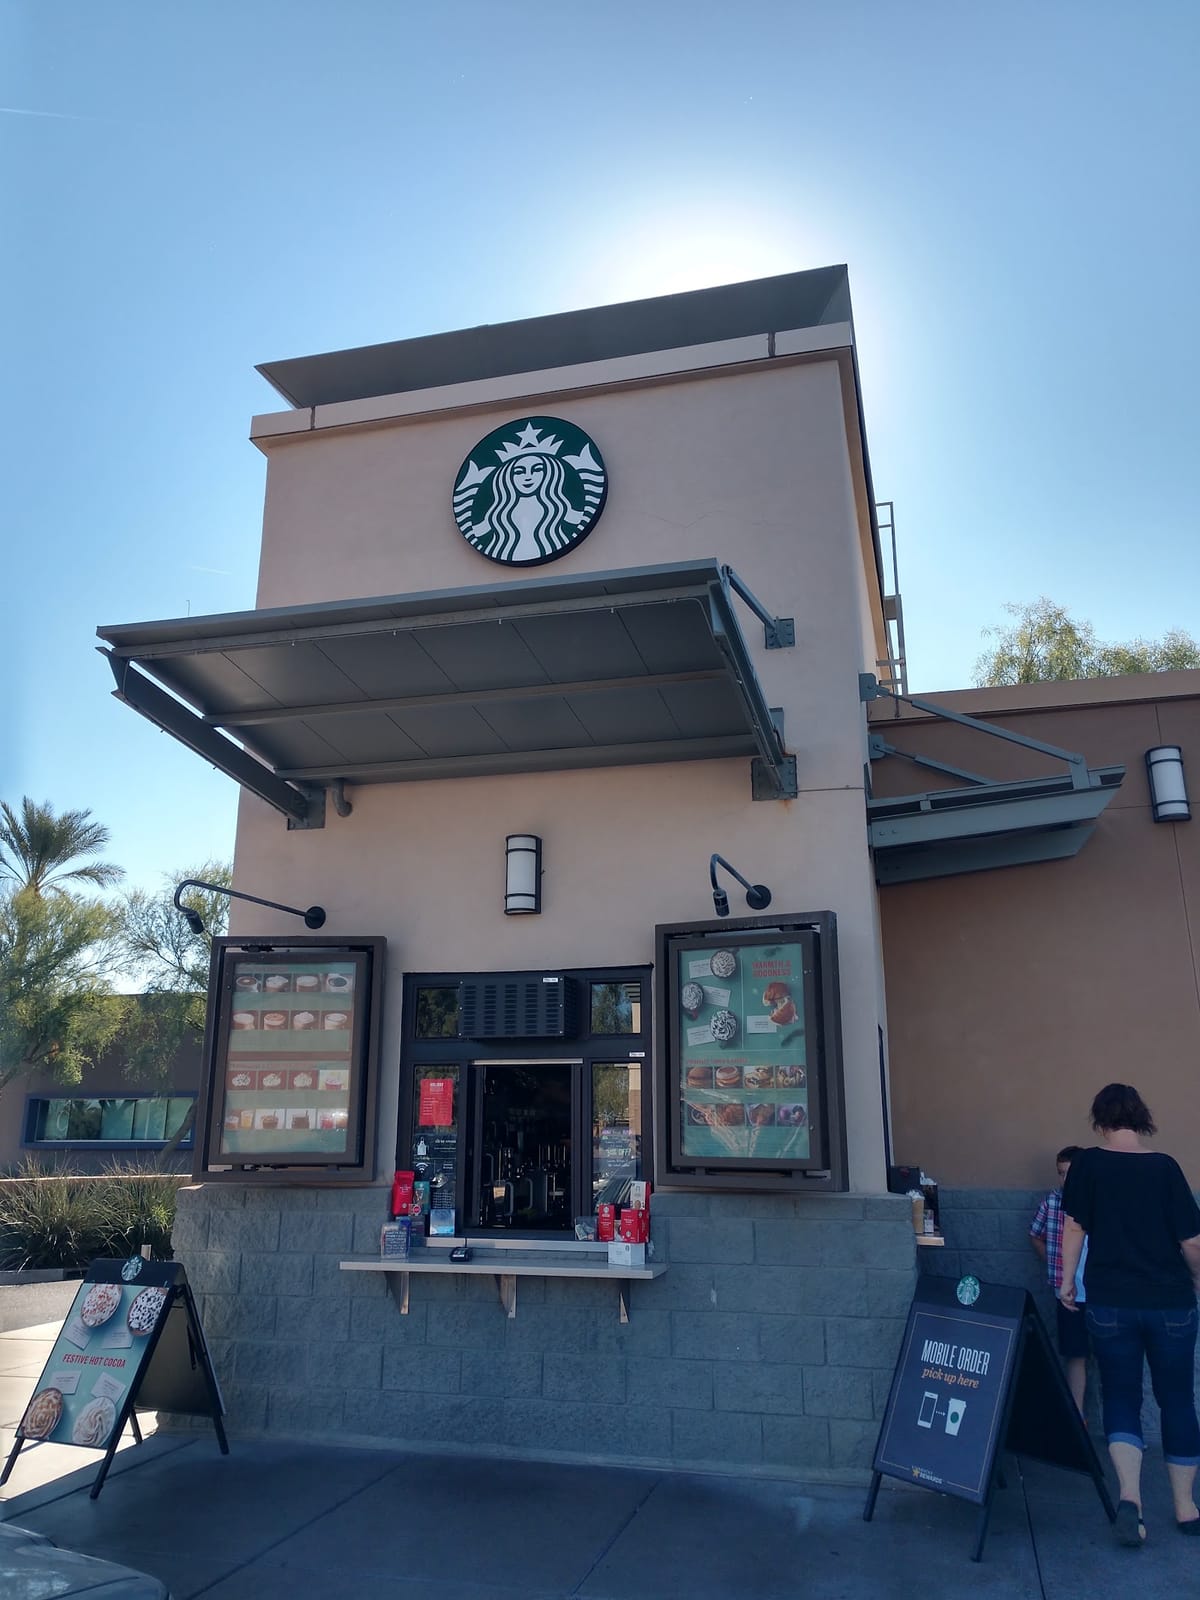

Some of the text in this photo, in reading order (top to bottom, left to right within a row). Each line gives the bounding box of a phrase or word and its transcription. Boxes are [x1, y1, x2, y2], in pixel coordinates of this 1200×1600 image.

[63, 1354, 126, 1368] FESTIVE HOT COCOA
[921, 1339, 991, 1376] MOBILE ORDER
[921, 1367, 980, 1389] pick up here
